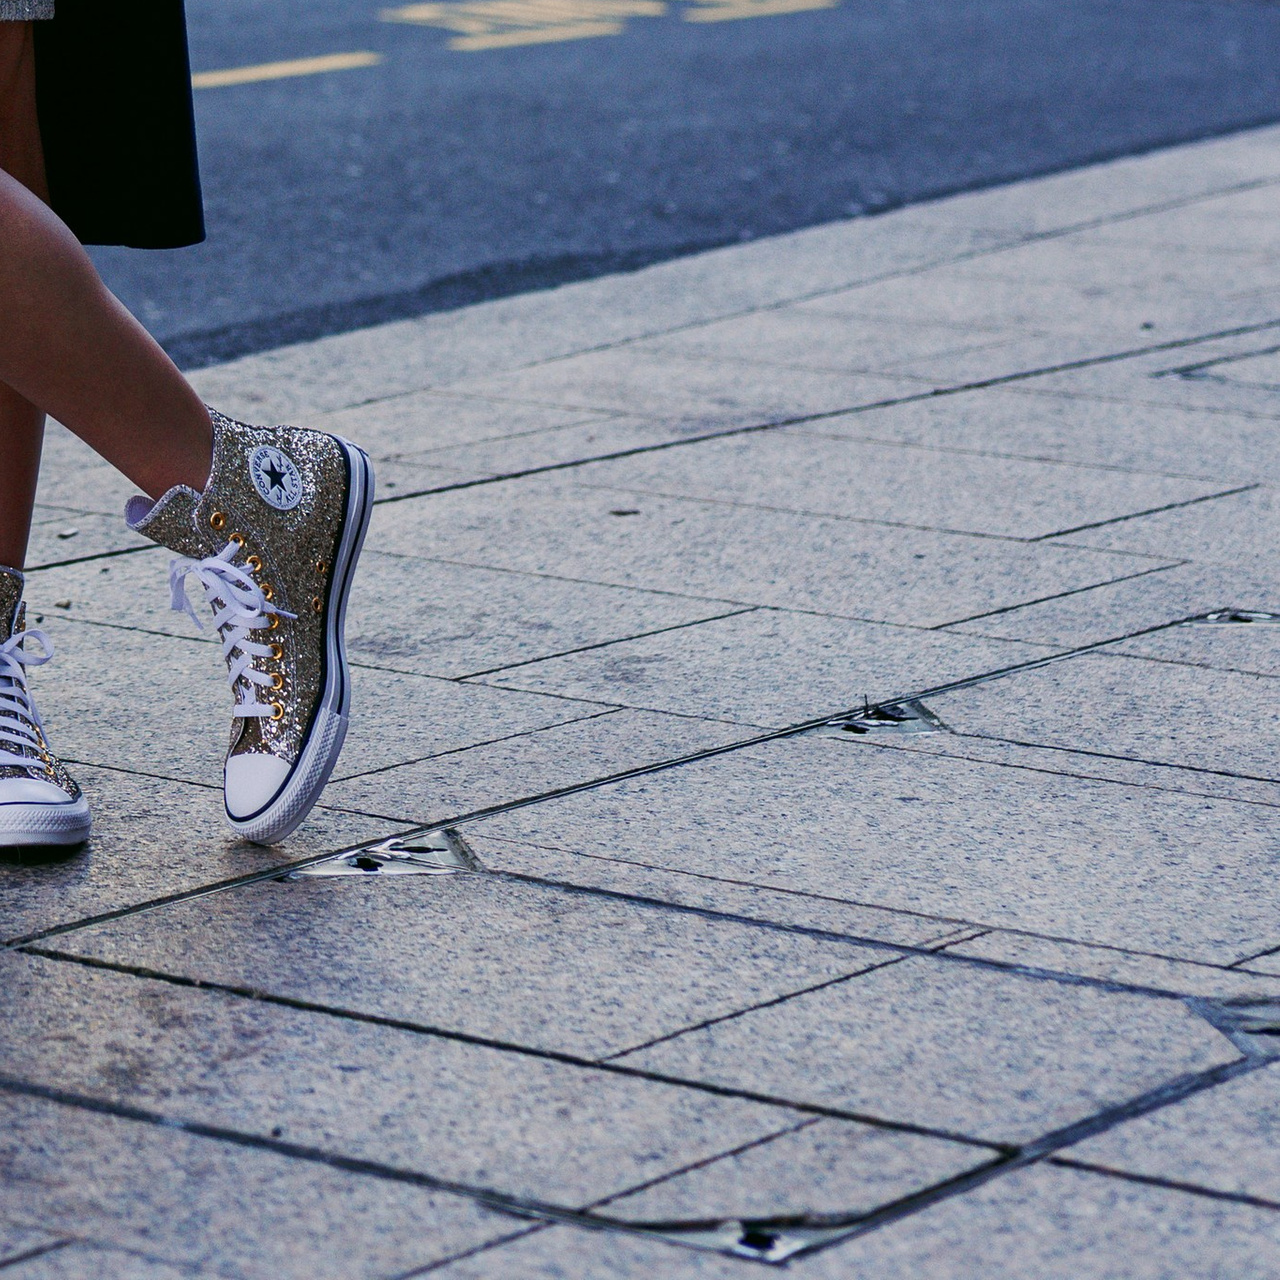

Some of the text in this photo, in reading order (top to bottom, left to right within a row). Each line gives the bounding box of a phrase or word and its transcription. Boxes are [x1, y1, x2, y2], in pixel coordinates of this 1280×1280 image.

[253, 450, 270, 495] CONVERSE
[286, 464, 299, 504] ALL STAR
